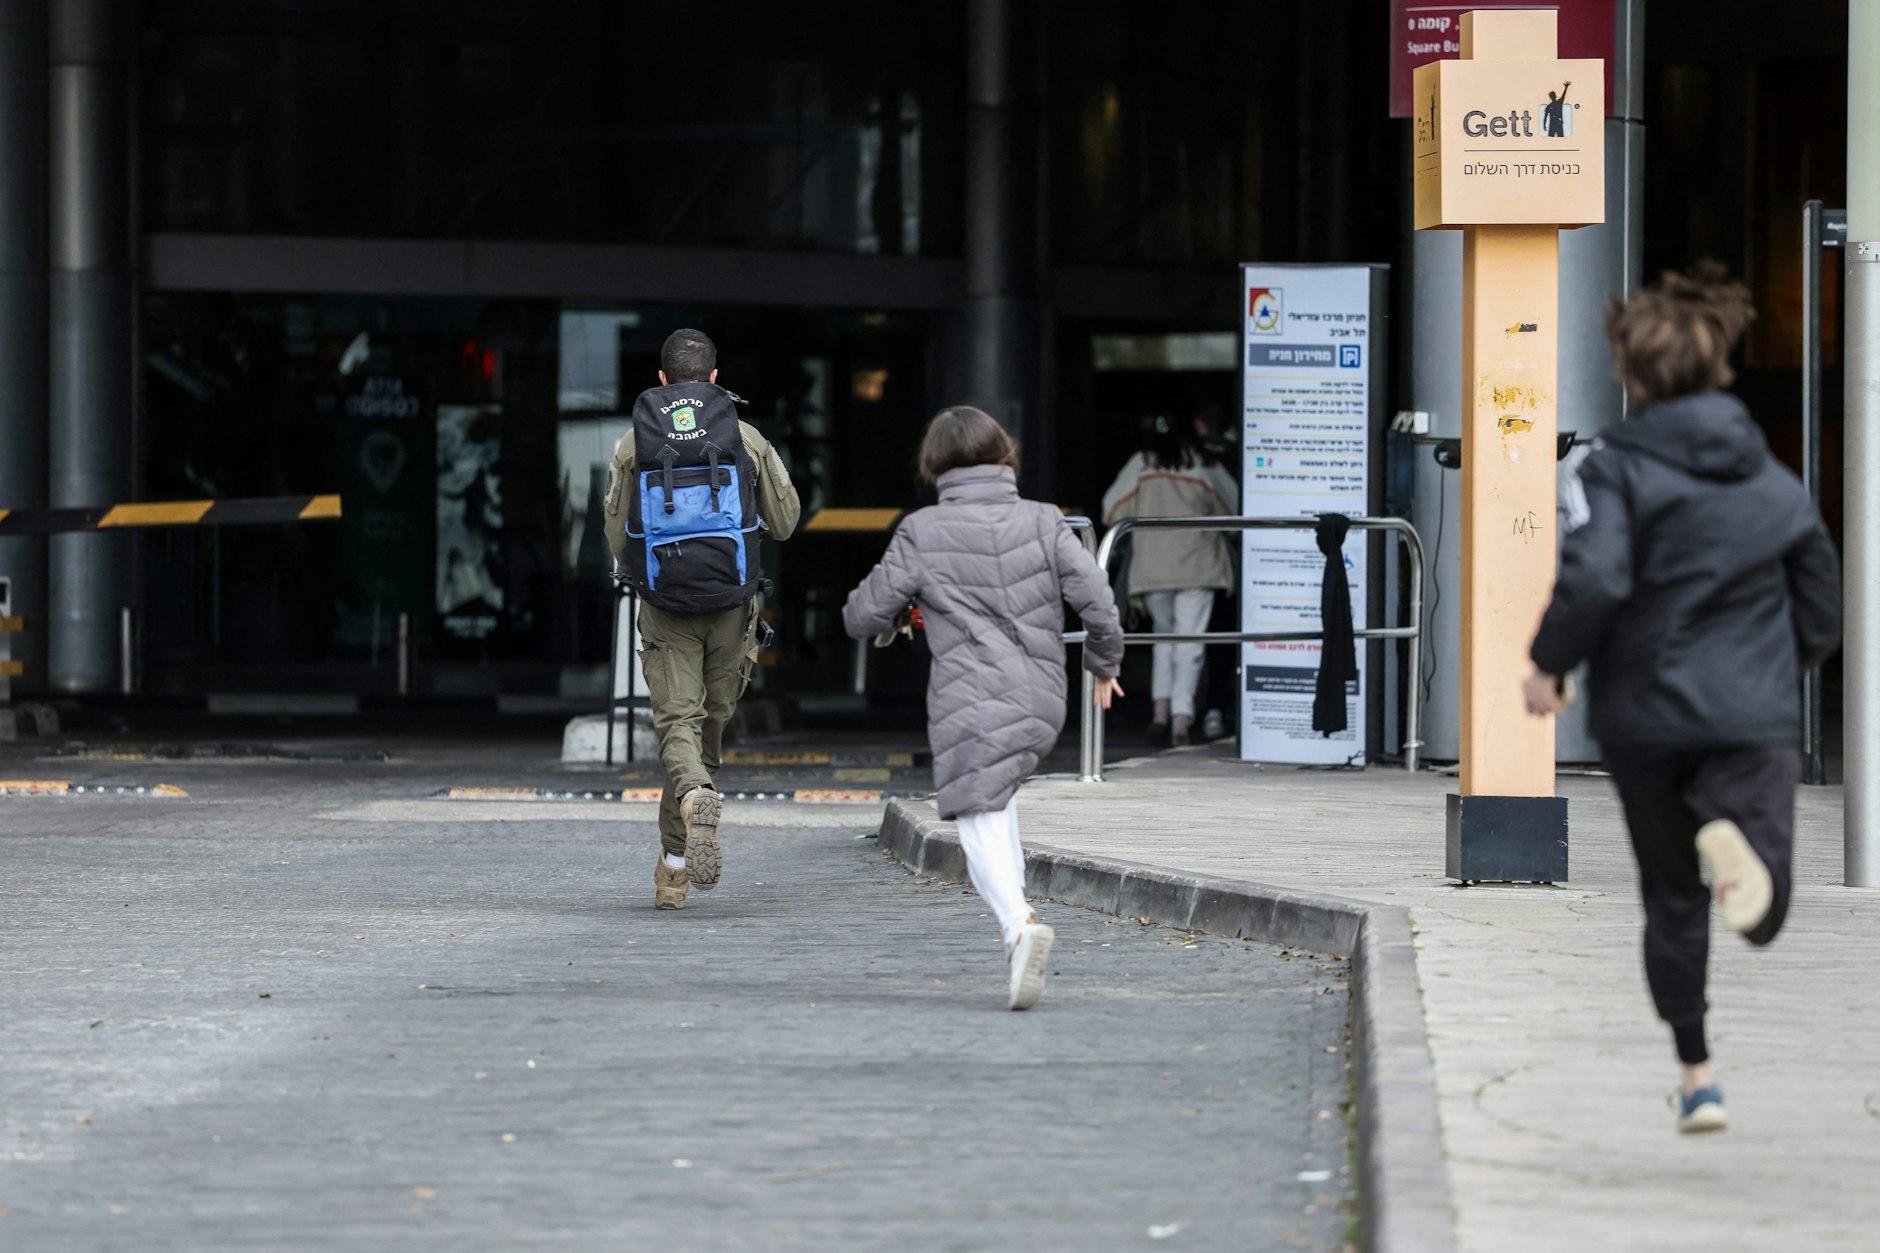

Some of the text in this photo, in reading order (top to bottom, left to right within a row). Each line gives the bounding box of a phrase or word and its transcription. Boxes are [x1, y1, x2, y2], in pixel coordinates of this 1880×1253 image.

[1417, 16, 1451, 33] קומה
[1407, 40, 1441, 56] Square
[1462, 109, 1533, 138] Gett
[1463, 161, 1581, 178] כניסת דרך השלום
[1288, 312, 1366, 324] חניון מרכז עזריאלי
[1329, 327, 1366, 337] תל אביב
[1268, 349, 1332, 364] מחירון חניה
[667, 428, 707, 441] באהבה
